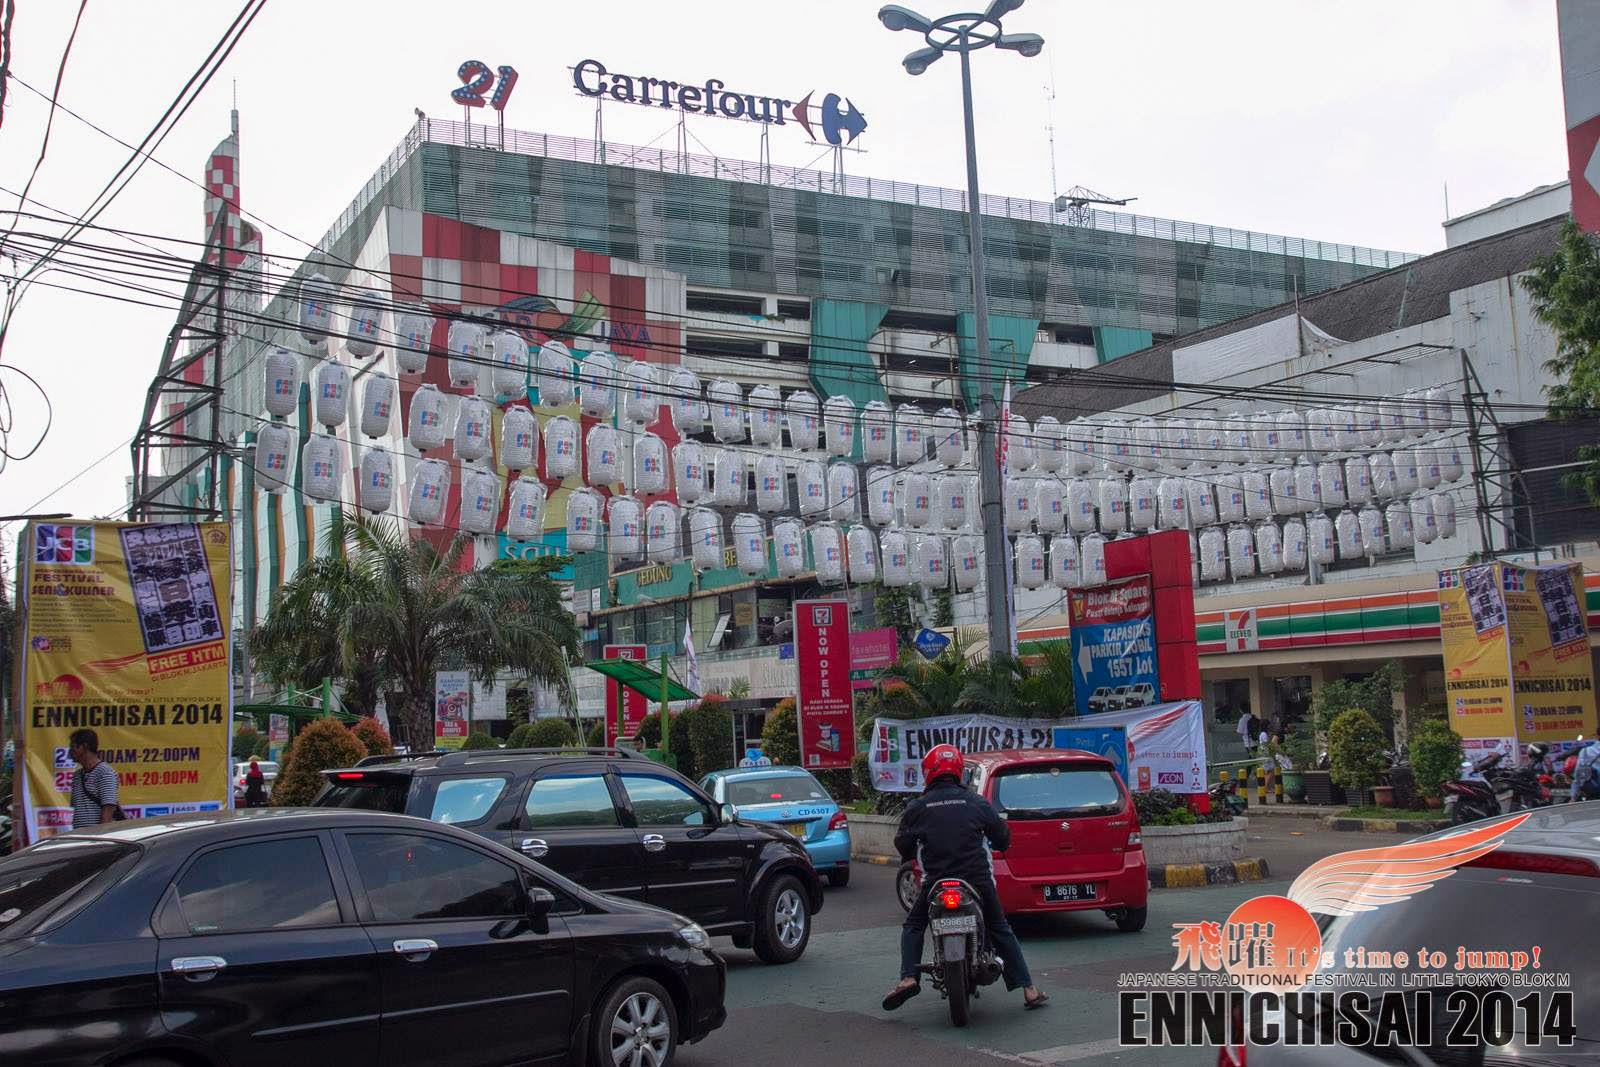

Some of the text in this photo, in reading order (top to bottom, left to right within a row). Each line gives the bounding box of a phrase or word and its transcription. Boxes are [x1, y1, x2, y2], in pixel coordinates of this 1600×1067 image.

[451, 60, 519, 111] 21
[573, 59, 791, 126] Carrefour
[819, 627, 829, 655] NOW
[150, 646, 225, 672] FREE HTM
[1108, 658, 1133, 678] 1557
[819, 660, 830, 697] OPEN
[1448, 678, 1508, 691] ENNICHISAI 2014
[1514, 678, 1591, 693] ENNICHISAI 2014
[32, 703, 222, 728] ENNICHISAI 2014
[906, 726, 1024, 759] ENNICHISAI
[1045, 883, 1096, 897] B 8676 YL
